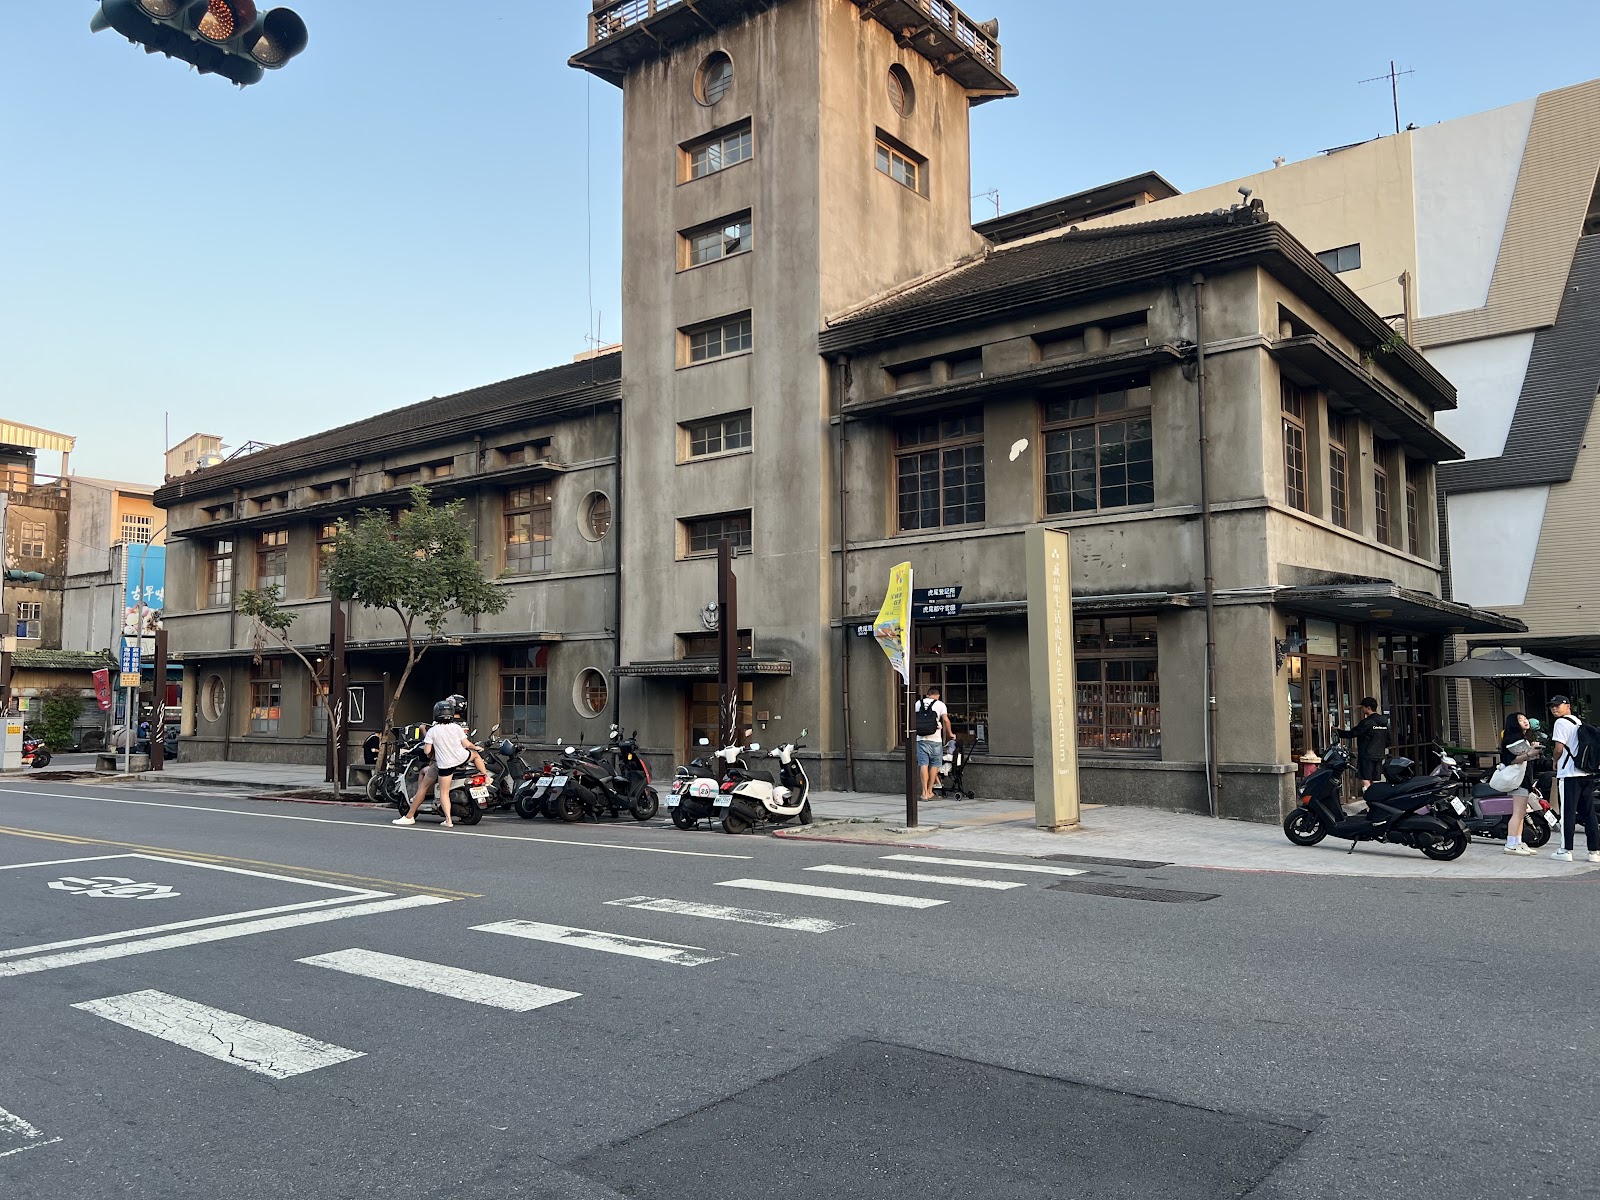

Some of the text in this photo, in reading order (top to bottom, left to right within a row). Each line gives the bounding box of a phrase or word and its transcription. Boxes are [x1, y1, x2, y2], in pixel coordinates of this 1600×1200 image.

[131, 585, 164, 602] 古早味
[1052, 562, 1062, 656] 誠品生活虎尾
[1056, 698, 1065, 762] spectrum
